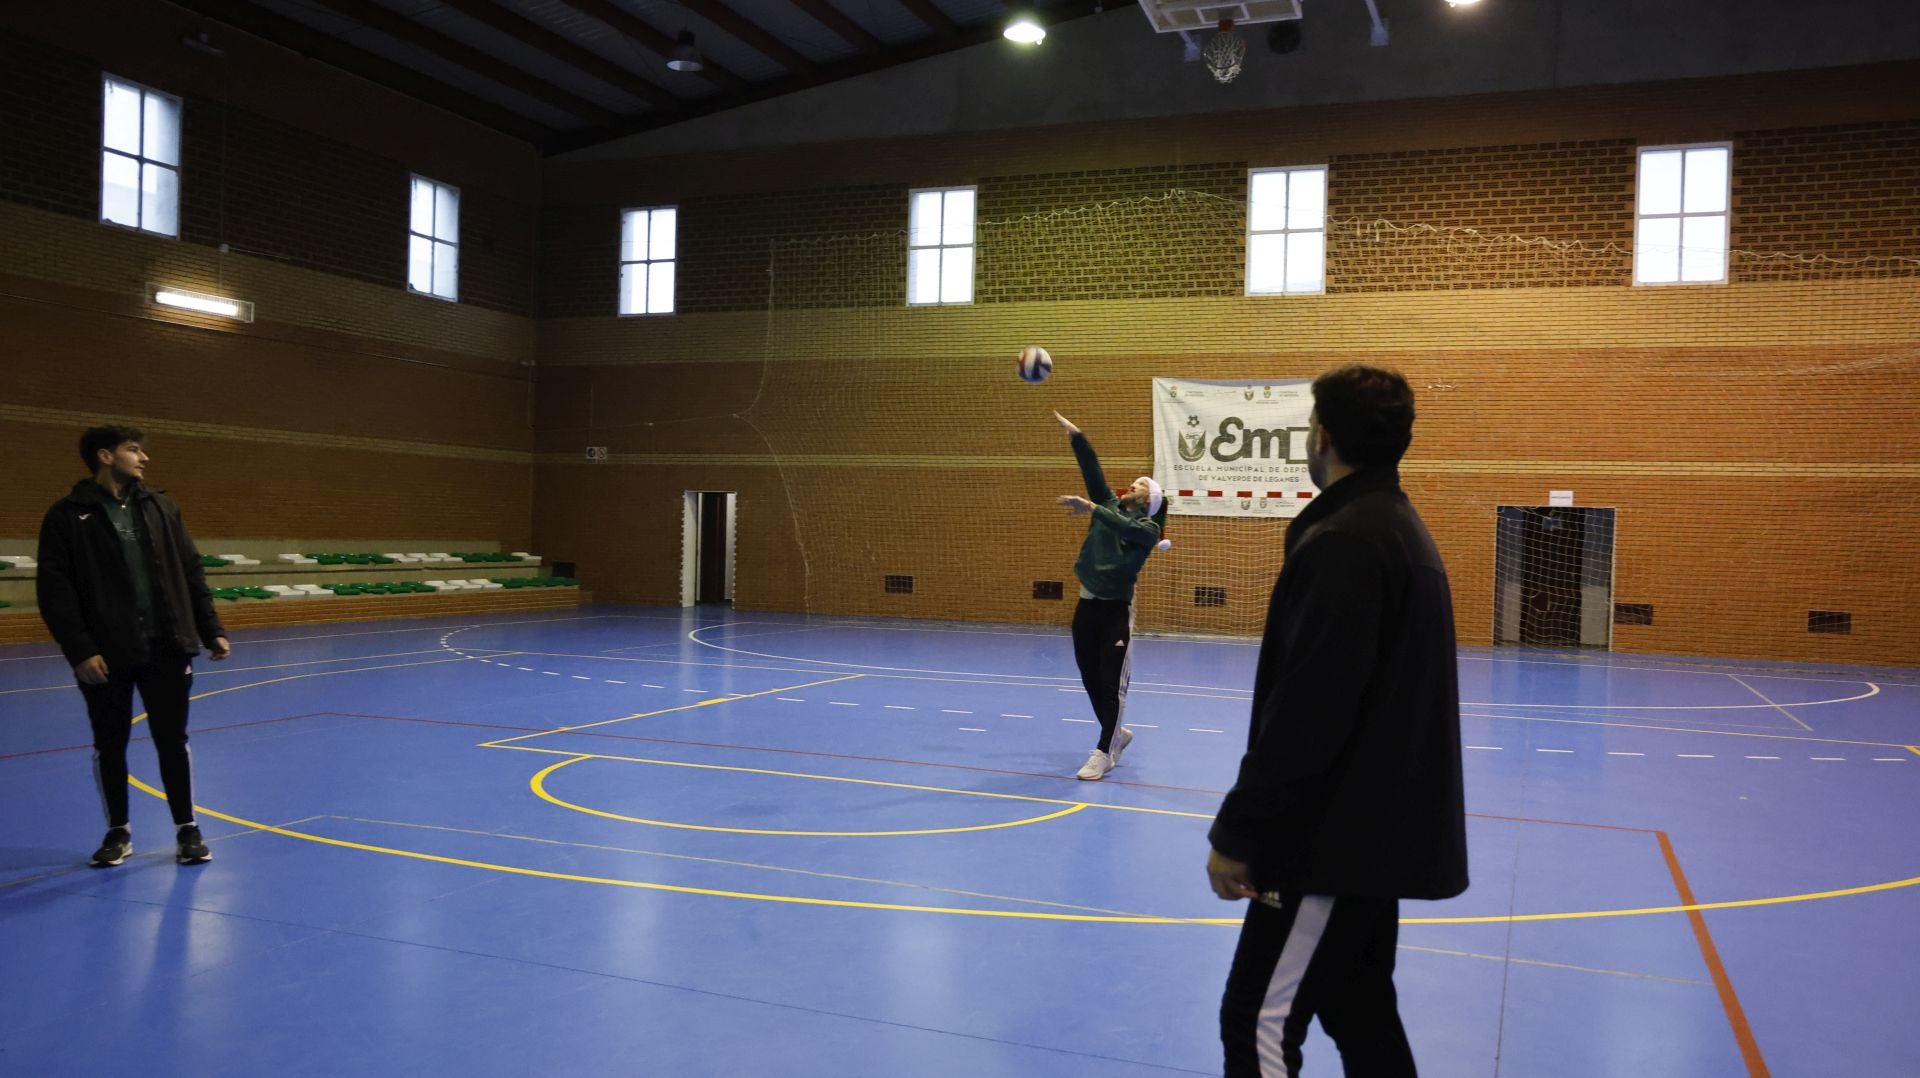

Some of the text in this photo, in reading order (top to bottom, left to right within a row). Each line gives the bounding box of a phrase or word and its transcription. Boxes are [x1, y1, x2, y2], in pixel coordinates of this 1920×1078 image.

[1174, 464, 1212, 472] ESCUELA
[1216, 465, 1265, 473] MUNICIPAL
[1283, 466, 1308, 474] DEPO
